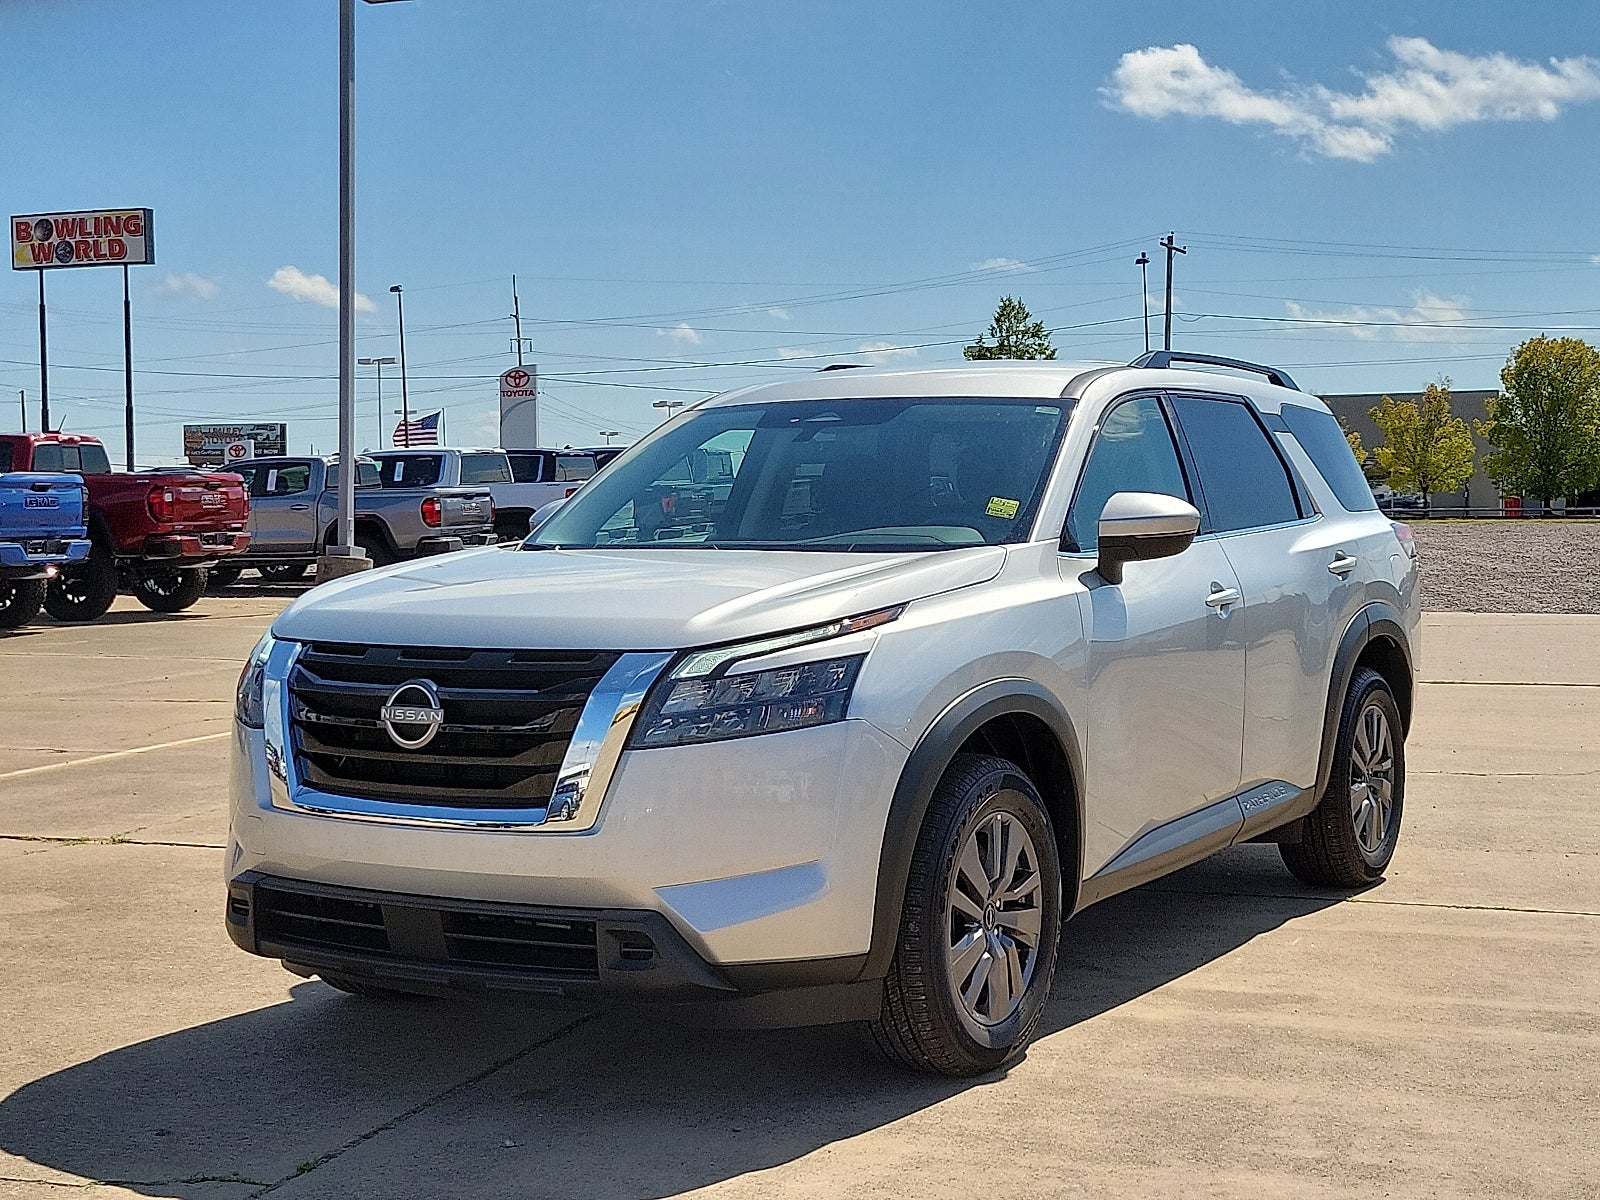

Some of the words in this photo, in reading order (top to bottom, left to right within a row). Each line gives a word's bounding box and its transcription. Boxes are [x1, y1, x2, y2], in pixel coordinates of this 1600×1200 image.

[15, 214, 143, 243] BOWLING
[29, 238, 127, 264] WORLD
[501, 389, 536, 398] TOYOTA
[26, 496, 59, 508] GMC
[382, 708, 442, 721] NISSAN
